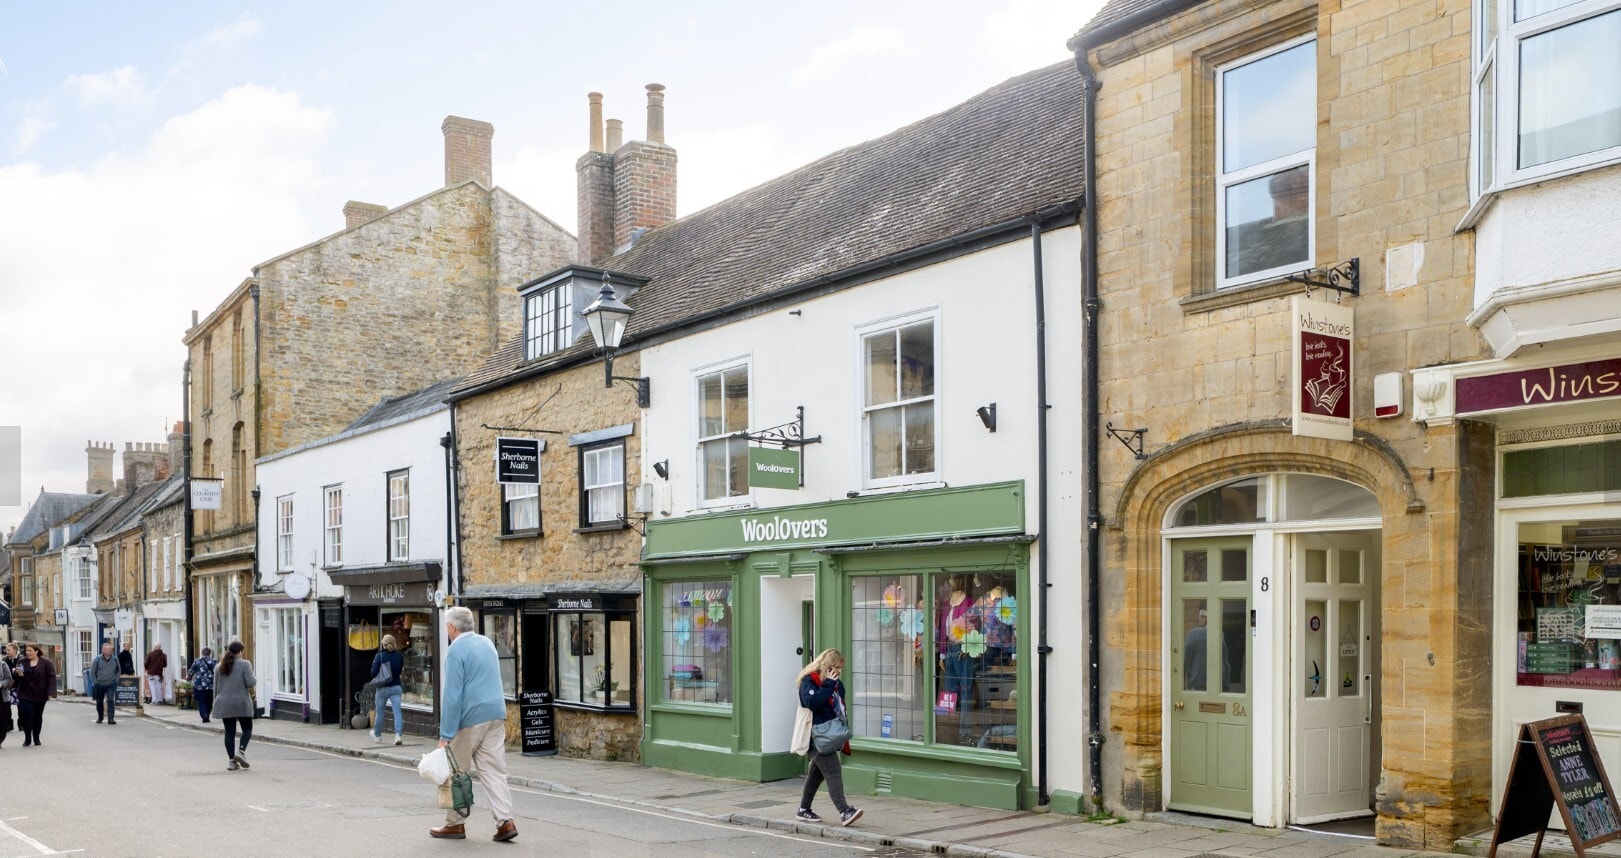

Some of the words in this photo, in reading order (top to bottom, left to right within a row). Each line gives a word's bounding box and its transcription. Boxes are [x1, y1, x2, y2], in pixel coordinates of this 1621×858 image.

[1300, 312, 1350, 336] Winstone's
[1521, 367, 1621, 403] Wins
[501, 452, 537, 461] Sherborne
[510, 461, 529, 470] Nails
[756, 463, 794, 473] WoolOvers
[741, 516, 828, 542] WoolOvers
[1534, 545, 1618, 562] Winstone's
[368, 583, 405, 599] ARTICHOKE
[1261, 577, 1269, 592] 8
[557, 599, 579, 608] Sherborne
[580, 598, 593, 608] Nails
[1232, 702, 1247, 717] 8A
[1549, 741, 1582, 758] Selected
[1559, 755, 1583, 772] ANNE
[1561, 768, 1590, 783] TYLER
